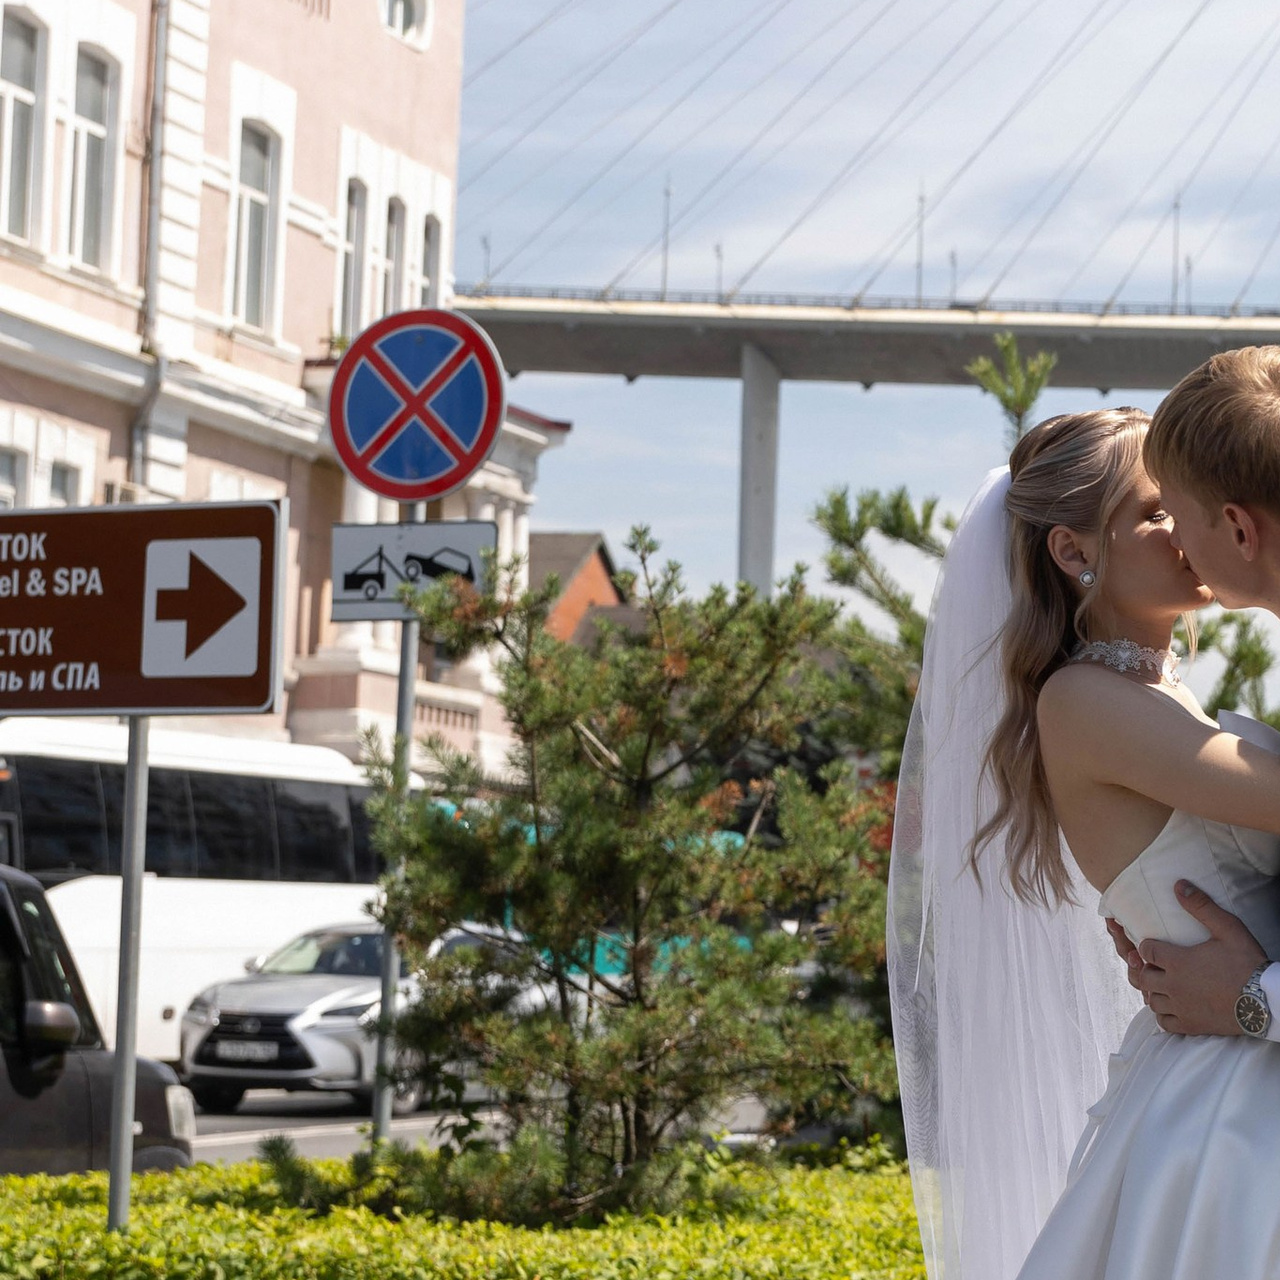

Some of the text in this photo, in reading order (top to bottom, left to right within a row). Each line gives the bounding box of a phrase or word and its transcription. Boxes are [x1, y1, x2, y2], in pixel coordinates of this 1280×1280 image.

[25, 567, 47, 597] &
[52, 566, 104, 596] SPA
[28, 670, 46, 692] и
[51, 661, 100, 691] СПА
